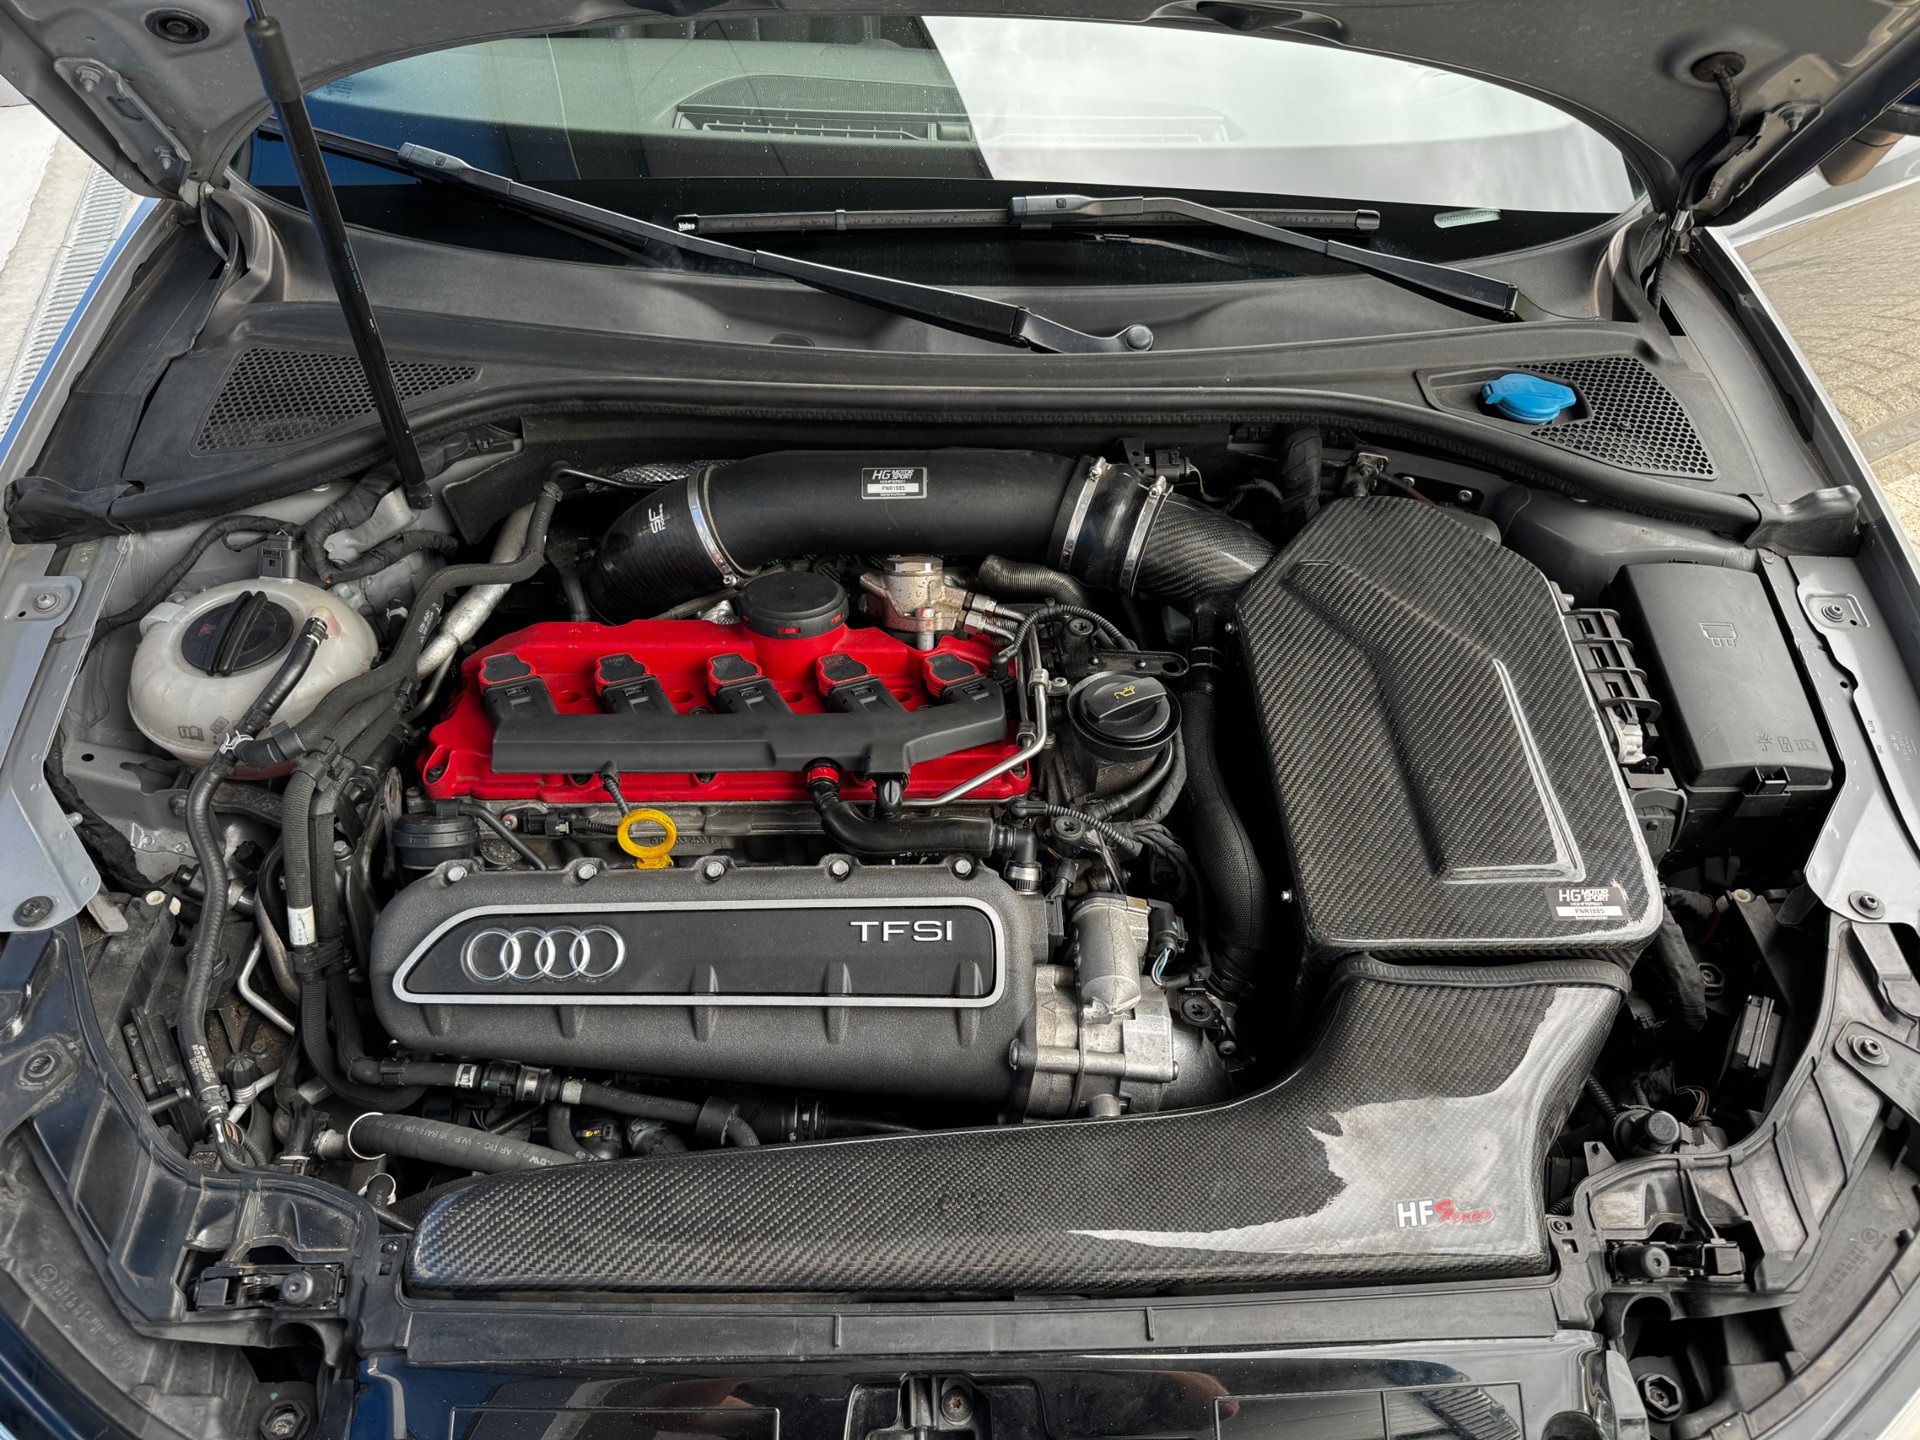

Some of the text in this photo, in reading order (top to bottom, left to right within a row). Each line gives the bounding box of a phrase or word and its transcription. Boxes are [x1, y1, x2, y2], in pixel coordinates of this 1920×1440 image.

[678, 222, 695, 231] Valeo
[871, 469, 891, 480] HG
[648, 508, 661, 534] SF
[1558, 888, 1609, 902] HG MOTOR
[850, 920, 953, 942] TFSI
[1397, 1200, 1434, 1228] HF
